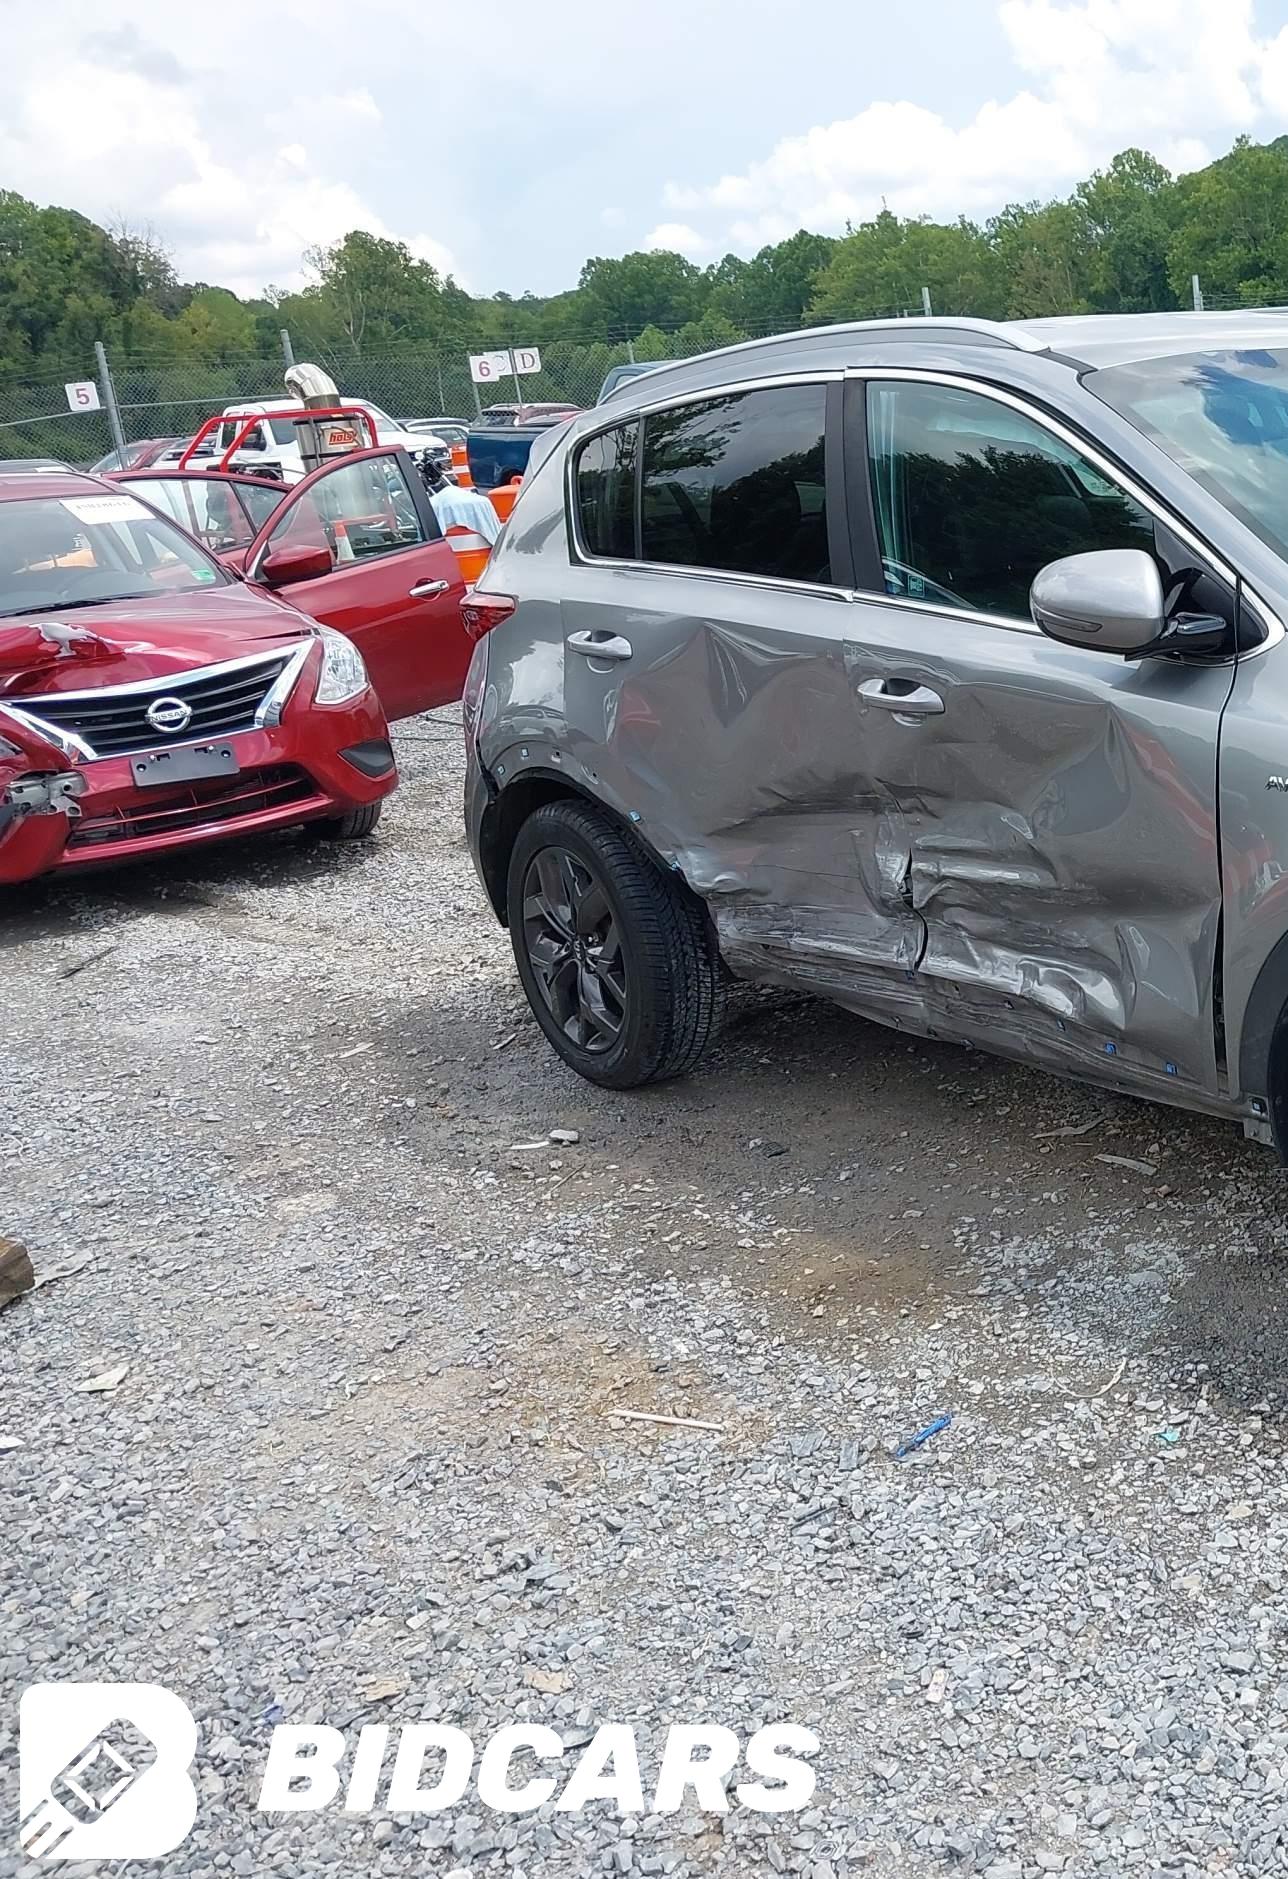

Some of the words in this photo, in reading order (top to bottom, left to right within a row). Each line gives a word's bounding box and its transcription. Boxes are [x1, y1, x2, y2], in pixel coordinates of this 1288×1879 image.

[478, 360, 491, 377] 6
[520, 352, 535, 369] D
[75, 387, 90, 405] 5
[151, 709, 188, 721] NISSAN
